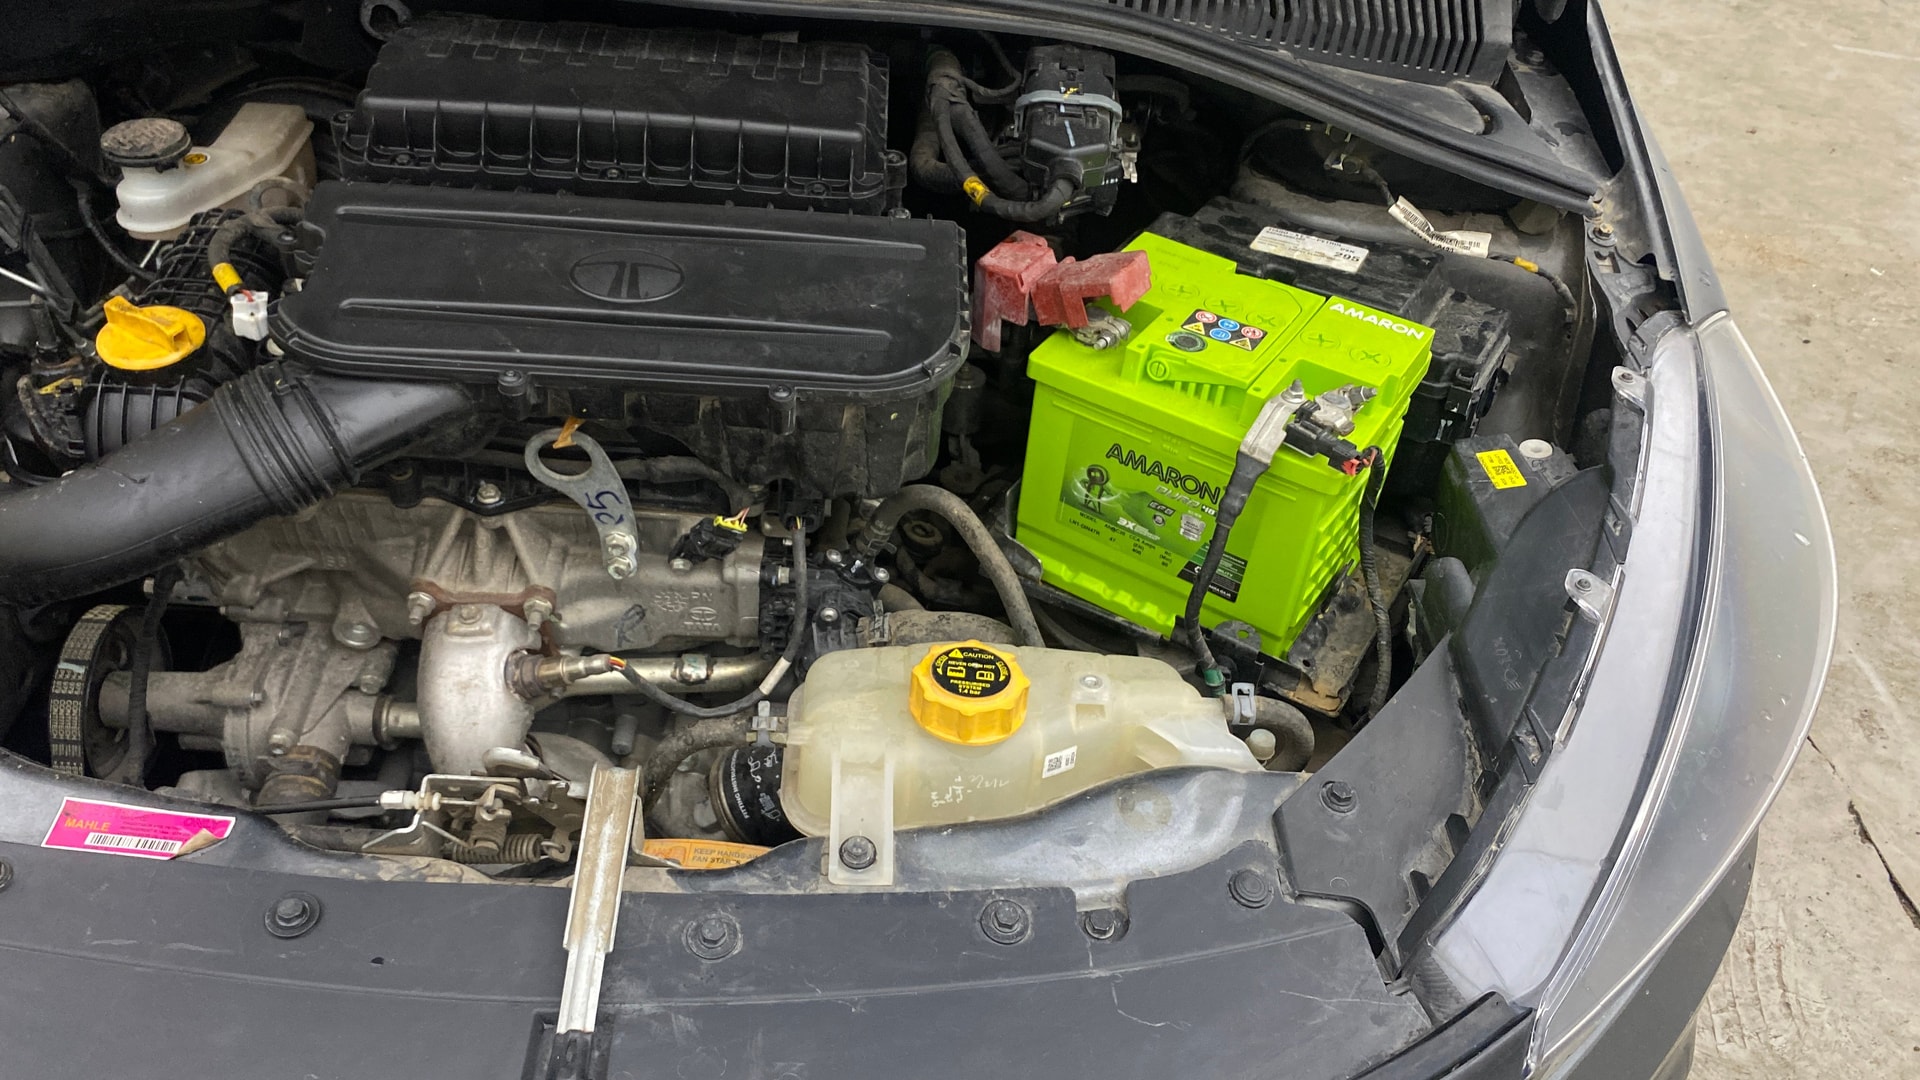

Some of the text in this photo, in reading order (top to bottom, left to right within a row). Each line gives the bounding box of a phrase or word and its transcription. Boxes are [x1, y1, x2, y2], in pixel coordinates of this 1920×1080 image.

[1329, 303, 1425, 340] AMARON
[1105, 443, 1221, 505] AMARON
[963, 651, 994, 660] CAUTION
[734, 793, 750, 819] FITTING
[65, 817, 111, 832] MAHLE
[694, 847, 716, 855] KEEP
[693, 855, 708, 863] FAN
